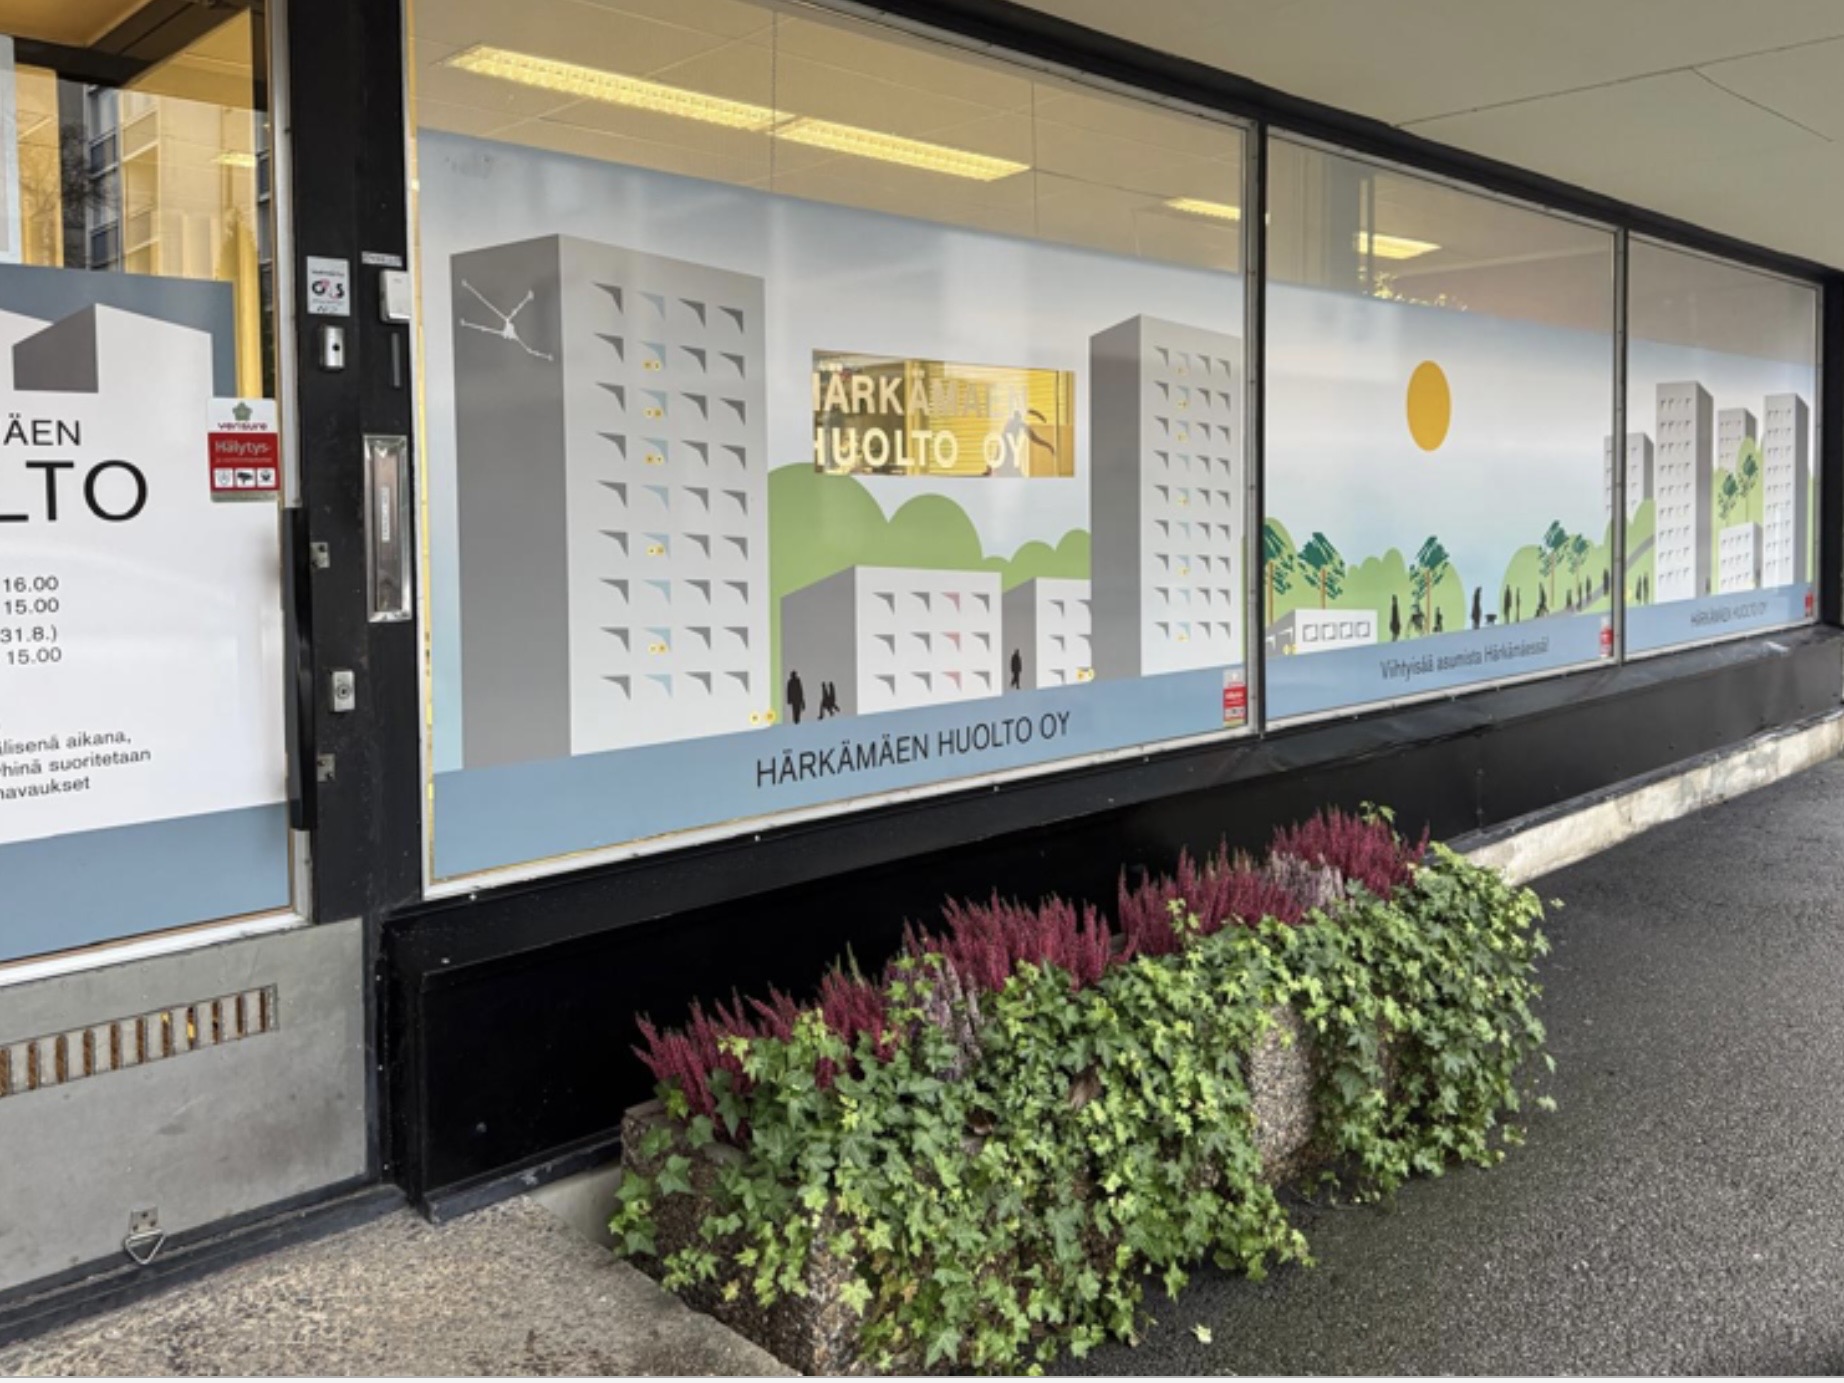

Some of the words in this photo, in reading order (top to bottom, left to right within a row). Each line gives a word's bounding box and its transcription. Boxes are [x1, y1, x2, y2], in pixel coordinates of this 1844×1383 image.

[312, 278, 345, 299] GS
[3, 412, 82, 446] ÄEN
[4, 576, 59, 593] 16.00
[4, 597, 60, 615] 15.00
[7, 647, 62, 665] 15.00
[0, 733, 60, 755] lisenä
[66, 731, 132, 749] aikana,
[756, 733, 929, 787] HÄRKÄMÄEN
[938, 715, 1033, 757] HUOLTO
[1040, 711, 1072, 741] OY
[0, 758, 41, 777] hinä
[49, 749, 151, 772] suoritetaan
